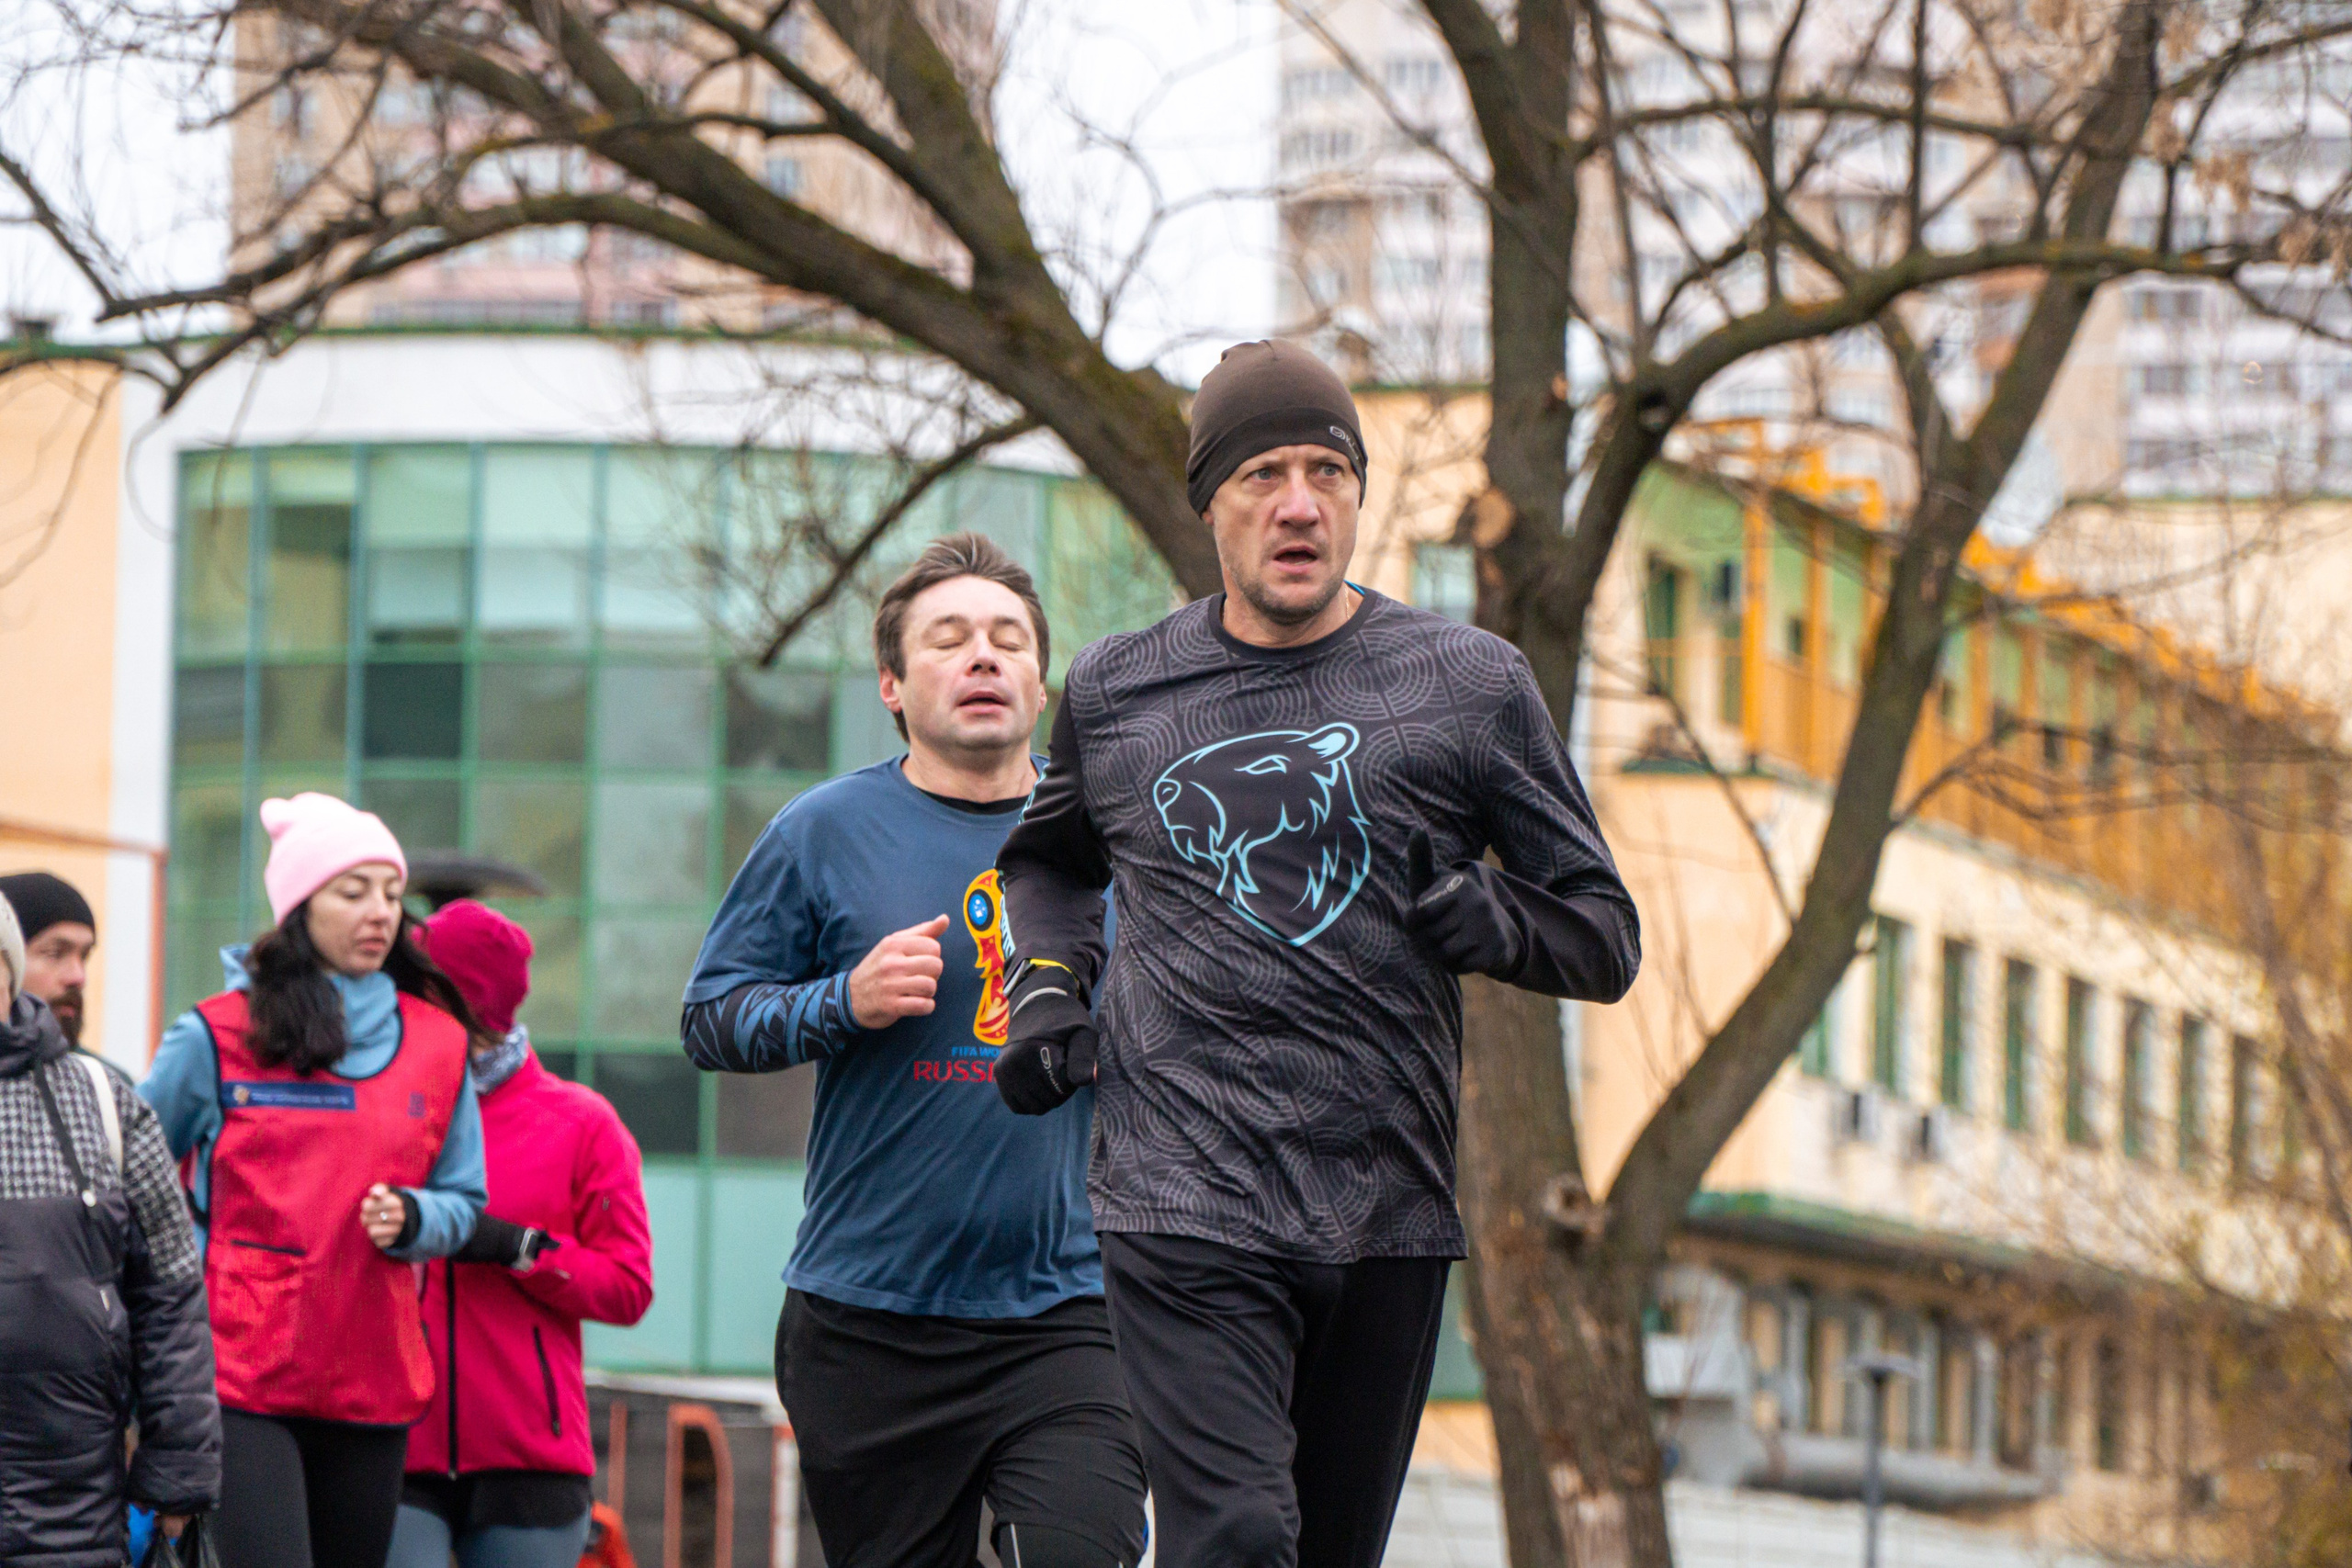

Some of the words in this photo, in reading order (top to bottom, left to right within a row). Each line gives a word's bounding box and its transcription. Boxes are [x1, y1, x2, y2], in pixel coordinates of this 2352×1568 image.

[951, 1045, 978, 1056] FIFA
[978, 1046, 1001, 1057] WO
[913, 1059, 997, 1083] RUSSI
